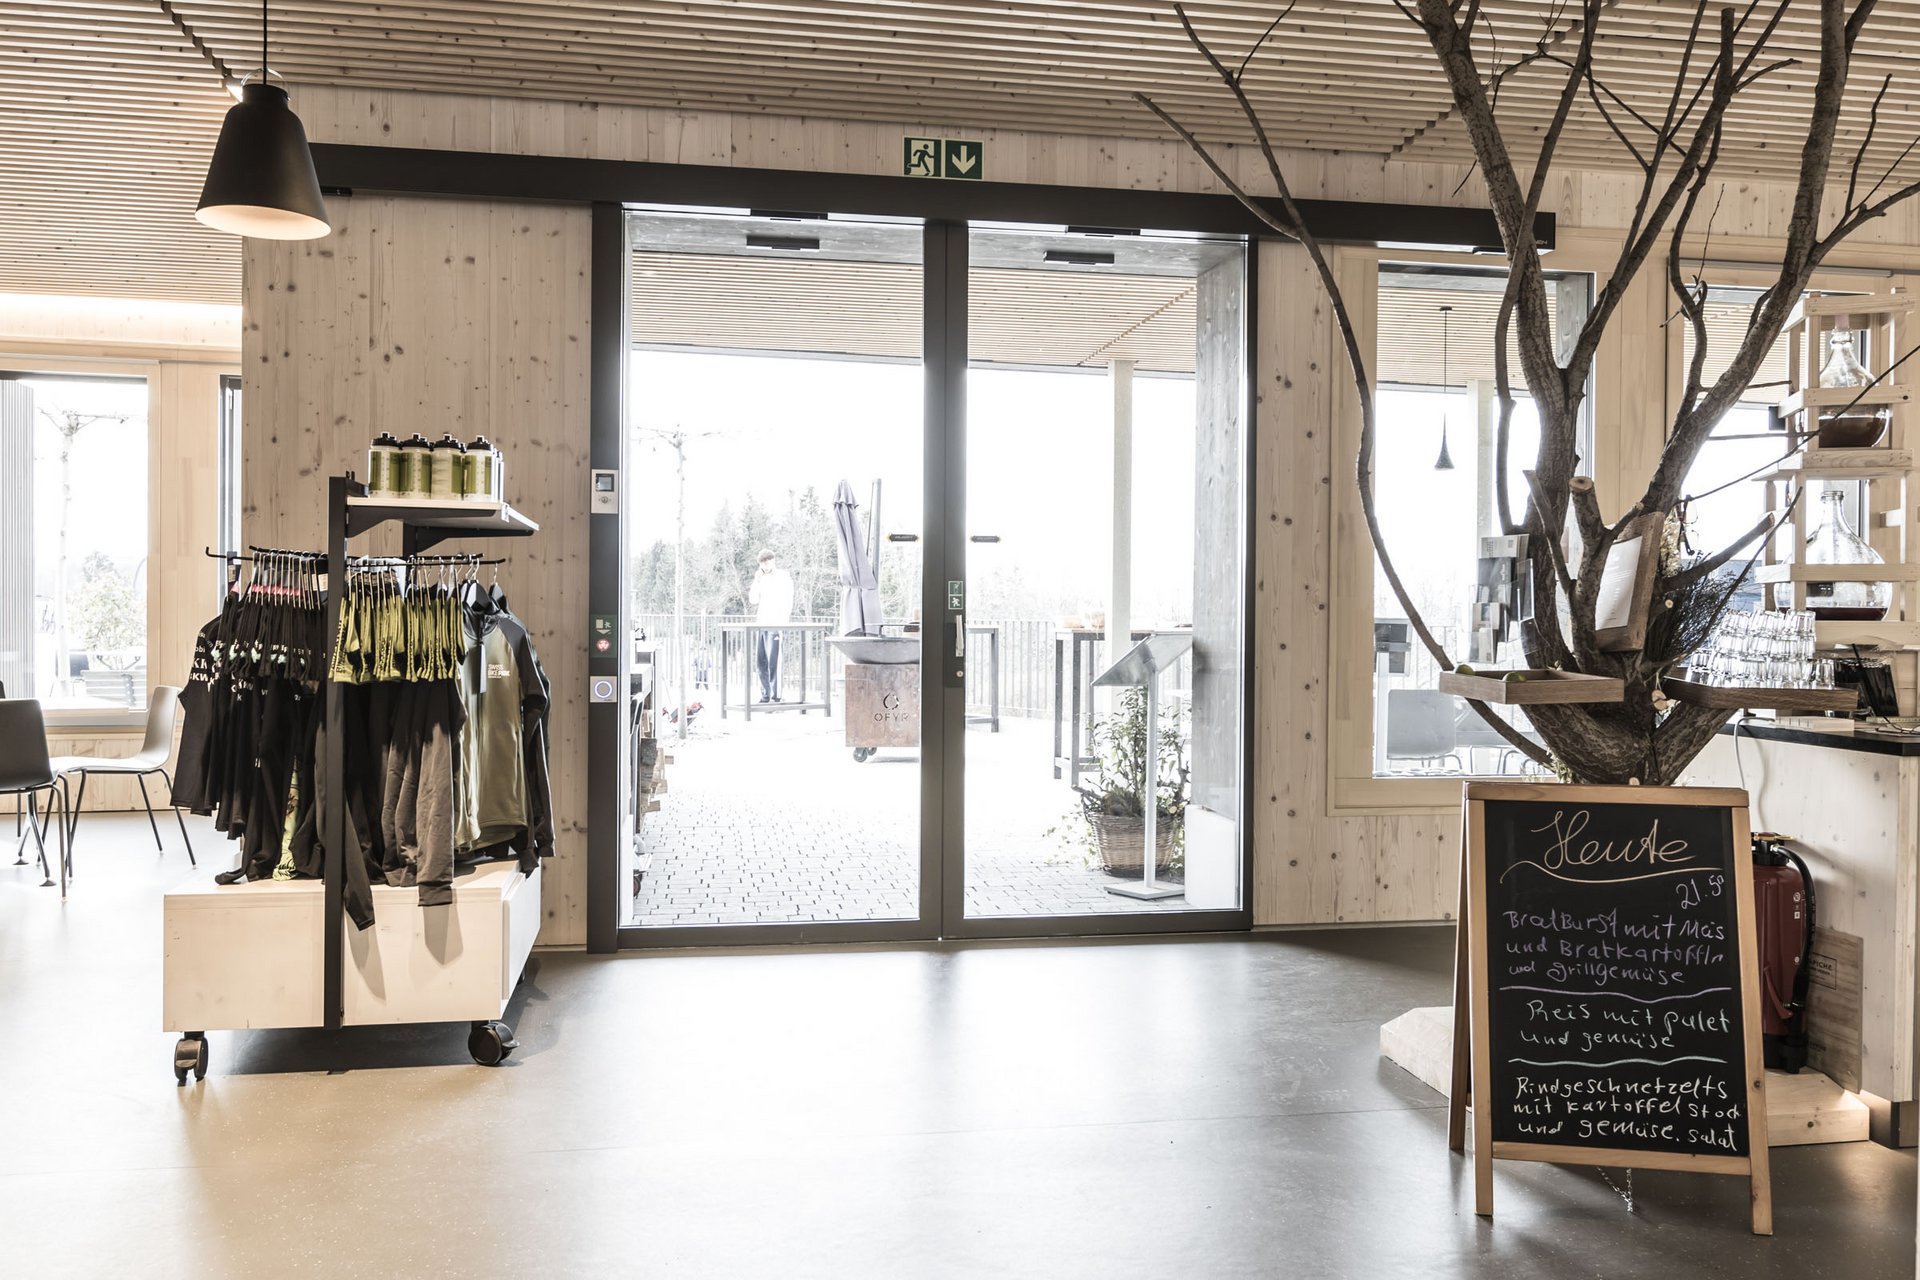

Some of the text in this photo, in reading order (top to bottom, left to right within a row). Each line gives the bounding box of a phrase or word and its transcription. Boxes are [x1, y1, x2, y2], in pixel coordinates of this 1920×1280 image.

[874, 713, 909, 722] OFYR
[1531, 810, 1696, 870] Heute
[1624, 914, 1676, 941] mit
[1506, 936, 1547, 954] und
[1508, 961, 1536, 976] und
[1526, 999, 1591, 1022] Reis
[1603, 1008, 1654, 1027] mit
[1513, 1096, 1552, 1115] mit
[1518, 1121, 1563, 1135] und
